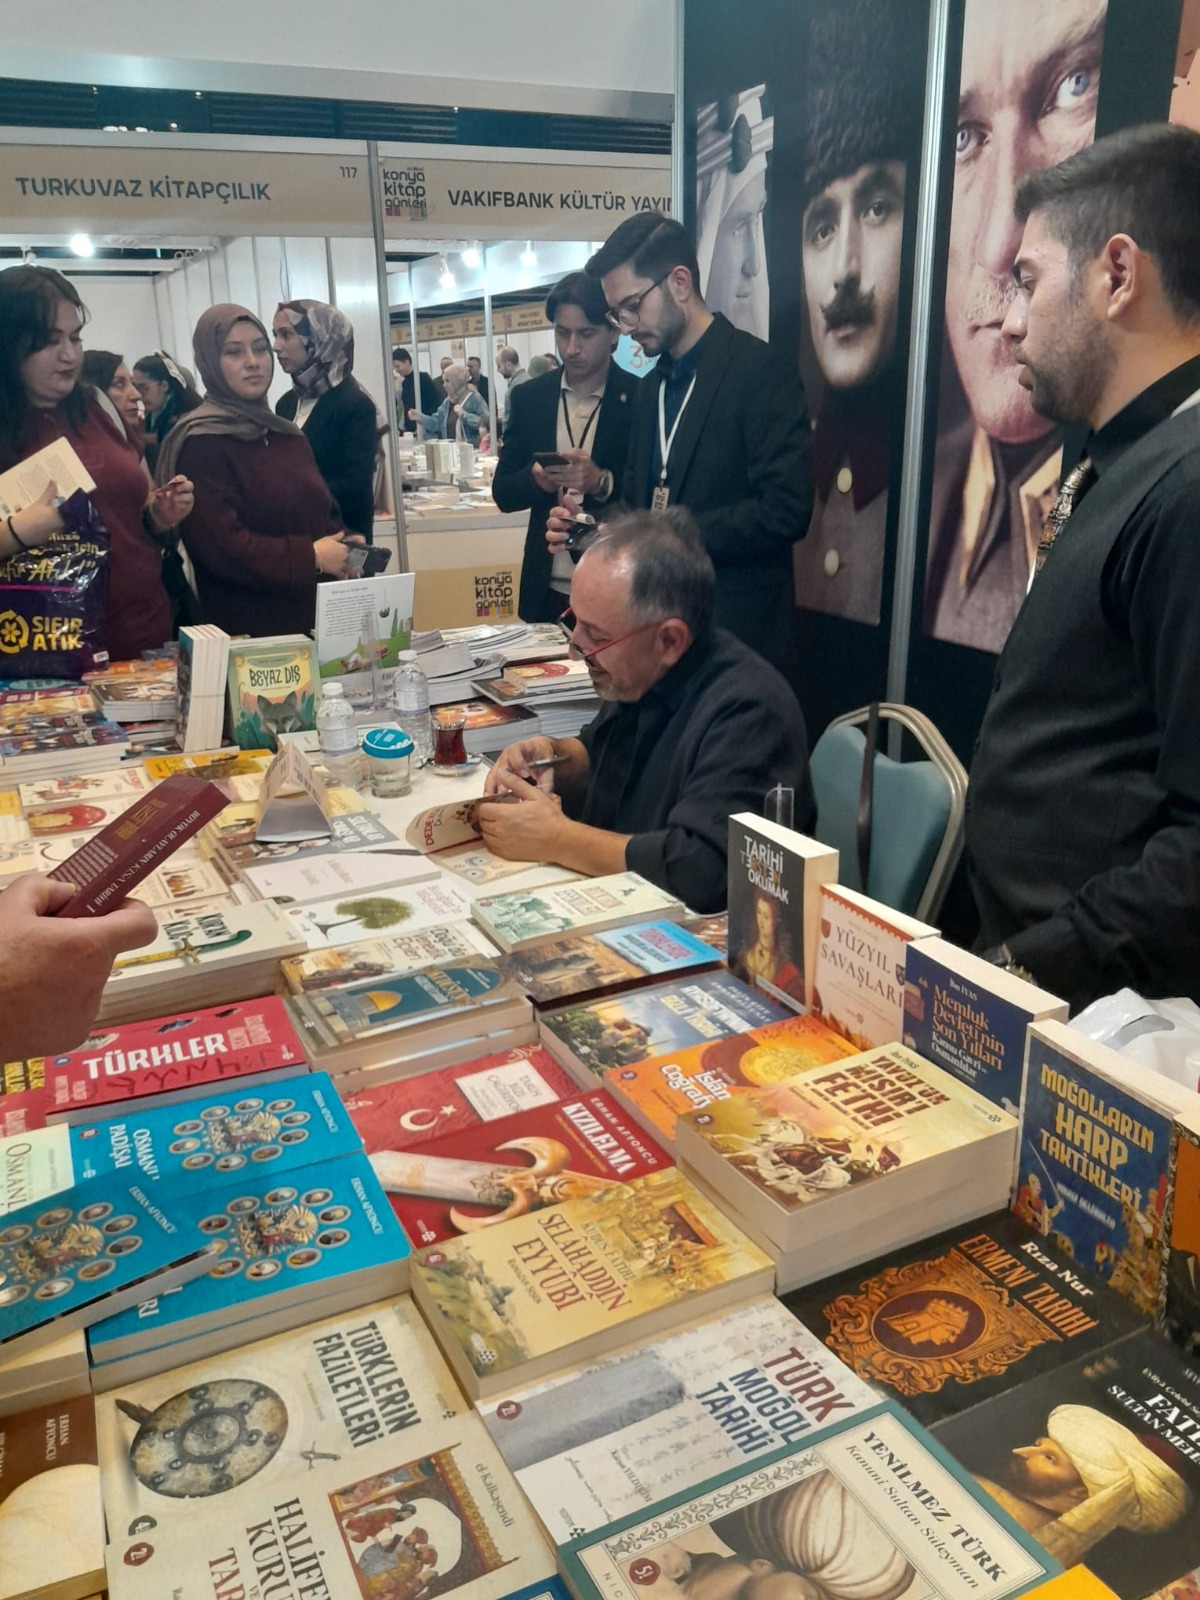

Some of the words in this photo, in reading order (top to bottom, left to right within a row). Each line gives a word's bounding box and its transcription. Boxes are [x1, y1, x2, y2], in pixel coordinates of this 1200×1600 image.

[15, 177, 143, 198] TURKUVAZ
[150, 175, 271, 204] KİTAPÇILIK
[340, 166, 358, 179] 117
[382, 168, 425, 184] konya
[384, 182, 426, 199] kitap
[448, 189, 553, 209] VAKIFBANK
[560, 190, 625, 211] KÜLTÜR
[475, 575, 512, 588] konya
[475, 585, 512, 599] kitap
[32, 615, 83, 633] SIFIR
[33, 634, 84, 651] ATIK
[249, 668, 282, 687] BEYAZ
[744, 835, 784, 874] TARİHİ
[747, 869, 789, 904] OKUMAK
[821, 943, 903, 1008] SAVAŞLARI
[835, 923, 891, 974] YÜZYIL
[934, 984, 989, 1030] Memluk
[83, 1032, 228, 1079] TÜRKLER
[933, 1016, 957, 1043] Son
[959, 1034, 1003, 1071] Yılları
[812, 1071, 904, 1127] FETHİ
[845, 1065, 930, 1115] MISIR'I
[1041, 1063, 1154, 1154] MOĞOLLARIN
[561, 1101, 637, 1175] KIZILELMA
[590, 1097, 616, 1128] ERHAN
[614, 1125, 657, 1165] AFYONCU
[1055, 1102, 1129, 1171] HARP
[6, 1143, 31, 1212] OSMANL
[1041, 1128, 1143, 1208] TAKTİKLERİ
[513, 1237, 594, 1312] EYYUBÎ
[538, 1213, 632, 1312] SELÂHADDİN
[958, 1232, 1036, 1289] ERMENİ
[1023, 1281, 1099, 1338] TARİHİ
[1020, 1241, 1058, 1271] Rıza
[1057, 1268, 1094, 1298] Nur
[313, 1332, 385, 1448] FAZİLETLERİ
[346, 1320, 421, 1436] TÜRKLERİN
[729, 1367, 812, 1445] MOĞOL
[763, 1346, 855, 1423] TÜRK
[46, 1418, 56, 1460] AFYONCU
[59, 1414, 69, 1446] ERHAN
[695, 1381, 776, 1455] TARİHİ
[1107, 1384, 1165, 1430] SULTAN
[1161, 1428, 1200, 1465] MEH
[845, 1445, 887, 1486] Kanuni
[885, 1484, 922, 1526] Sultan
[920, 1524, 980, 1590] Süleyman
[862, 1430, 954, 1522] YENİLMEZ
[954, 1522, 1008, 1583] TÜRK
